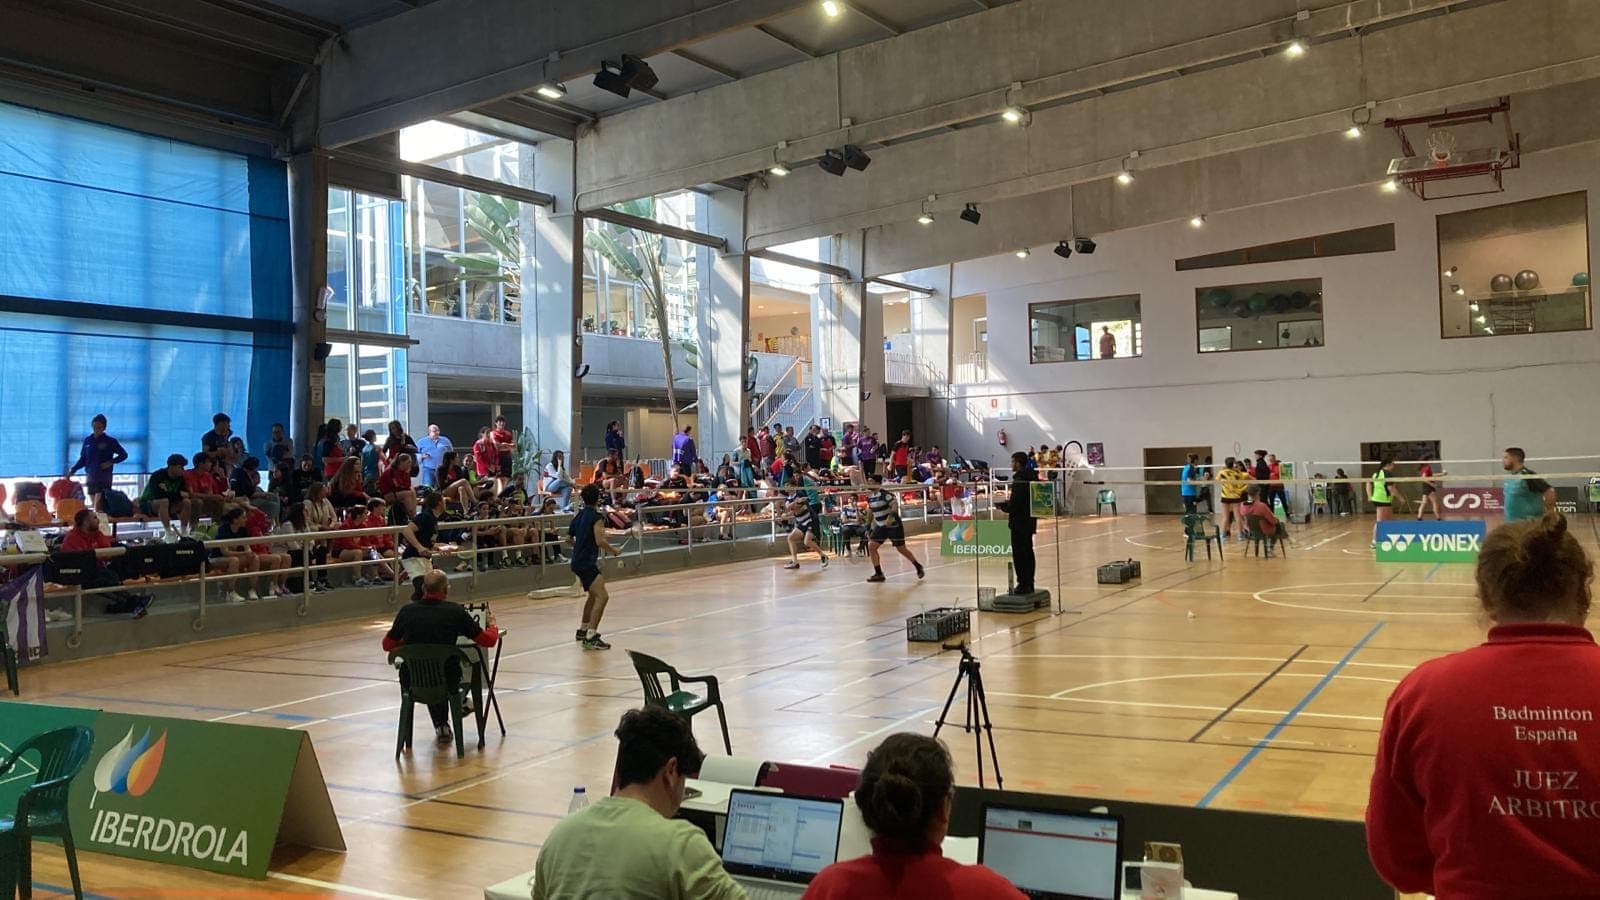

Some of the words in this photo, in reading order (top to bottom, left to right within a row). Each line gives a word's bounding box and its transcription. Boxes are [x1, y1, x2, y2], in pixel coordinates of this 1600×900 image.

[953, 544, 1013, 555] IBERDROLA
[1419, 534, 1480, 551] YONEX
[1493, 705, 1593, 721] Badminton
[1514, 726, 1578, 745] España
[1513, 769, 1579, 790] JUEZ
[90, 809, 248, 866] IBERDROLA
